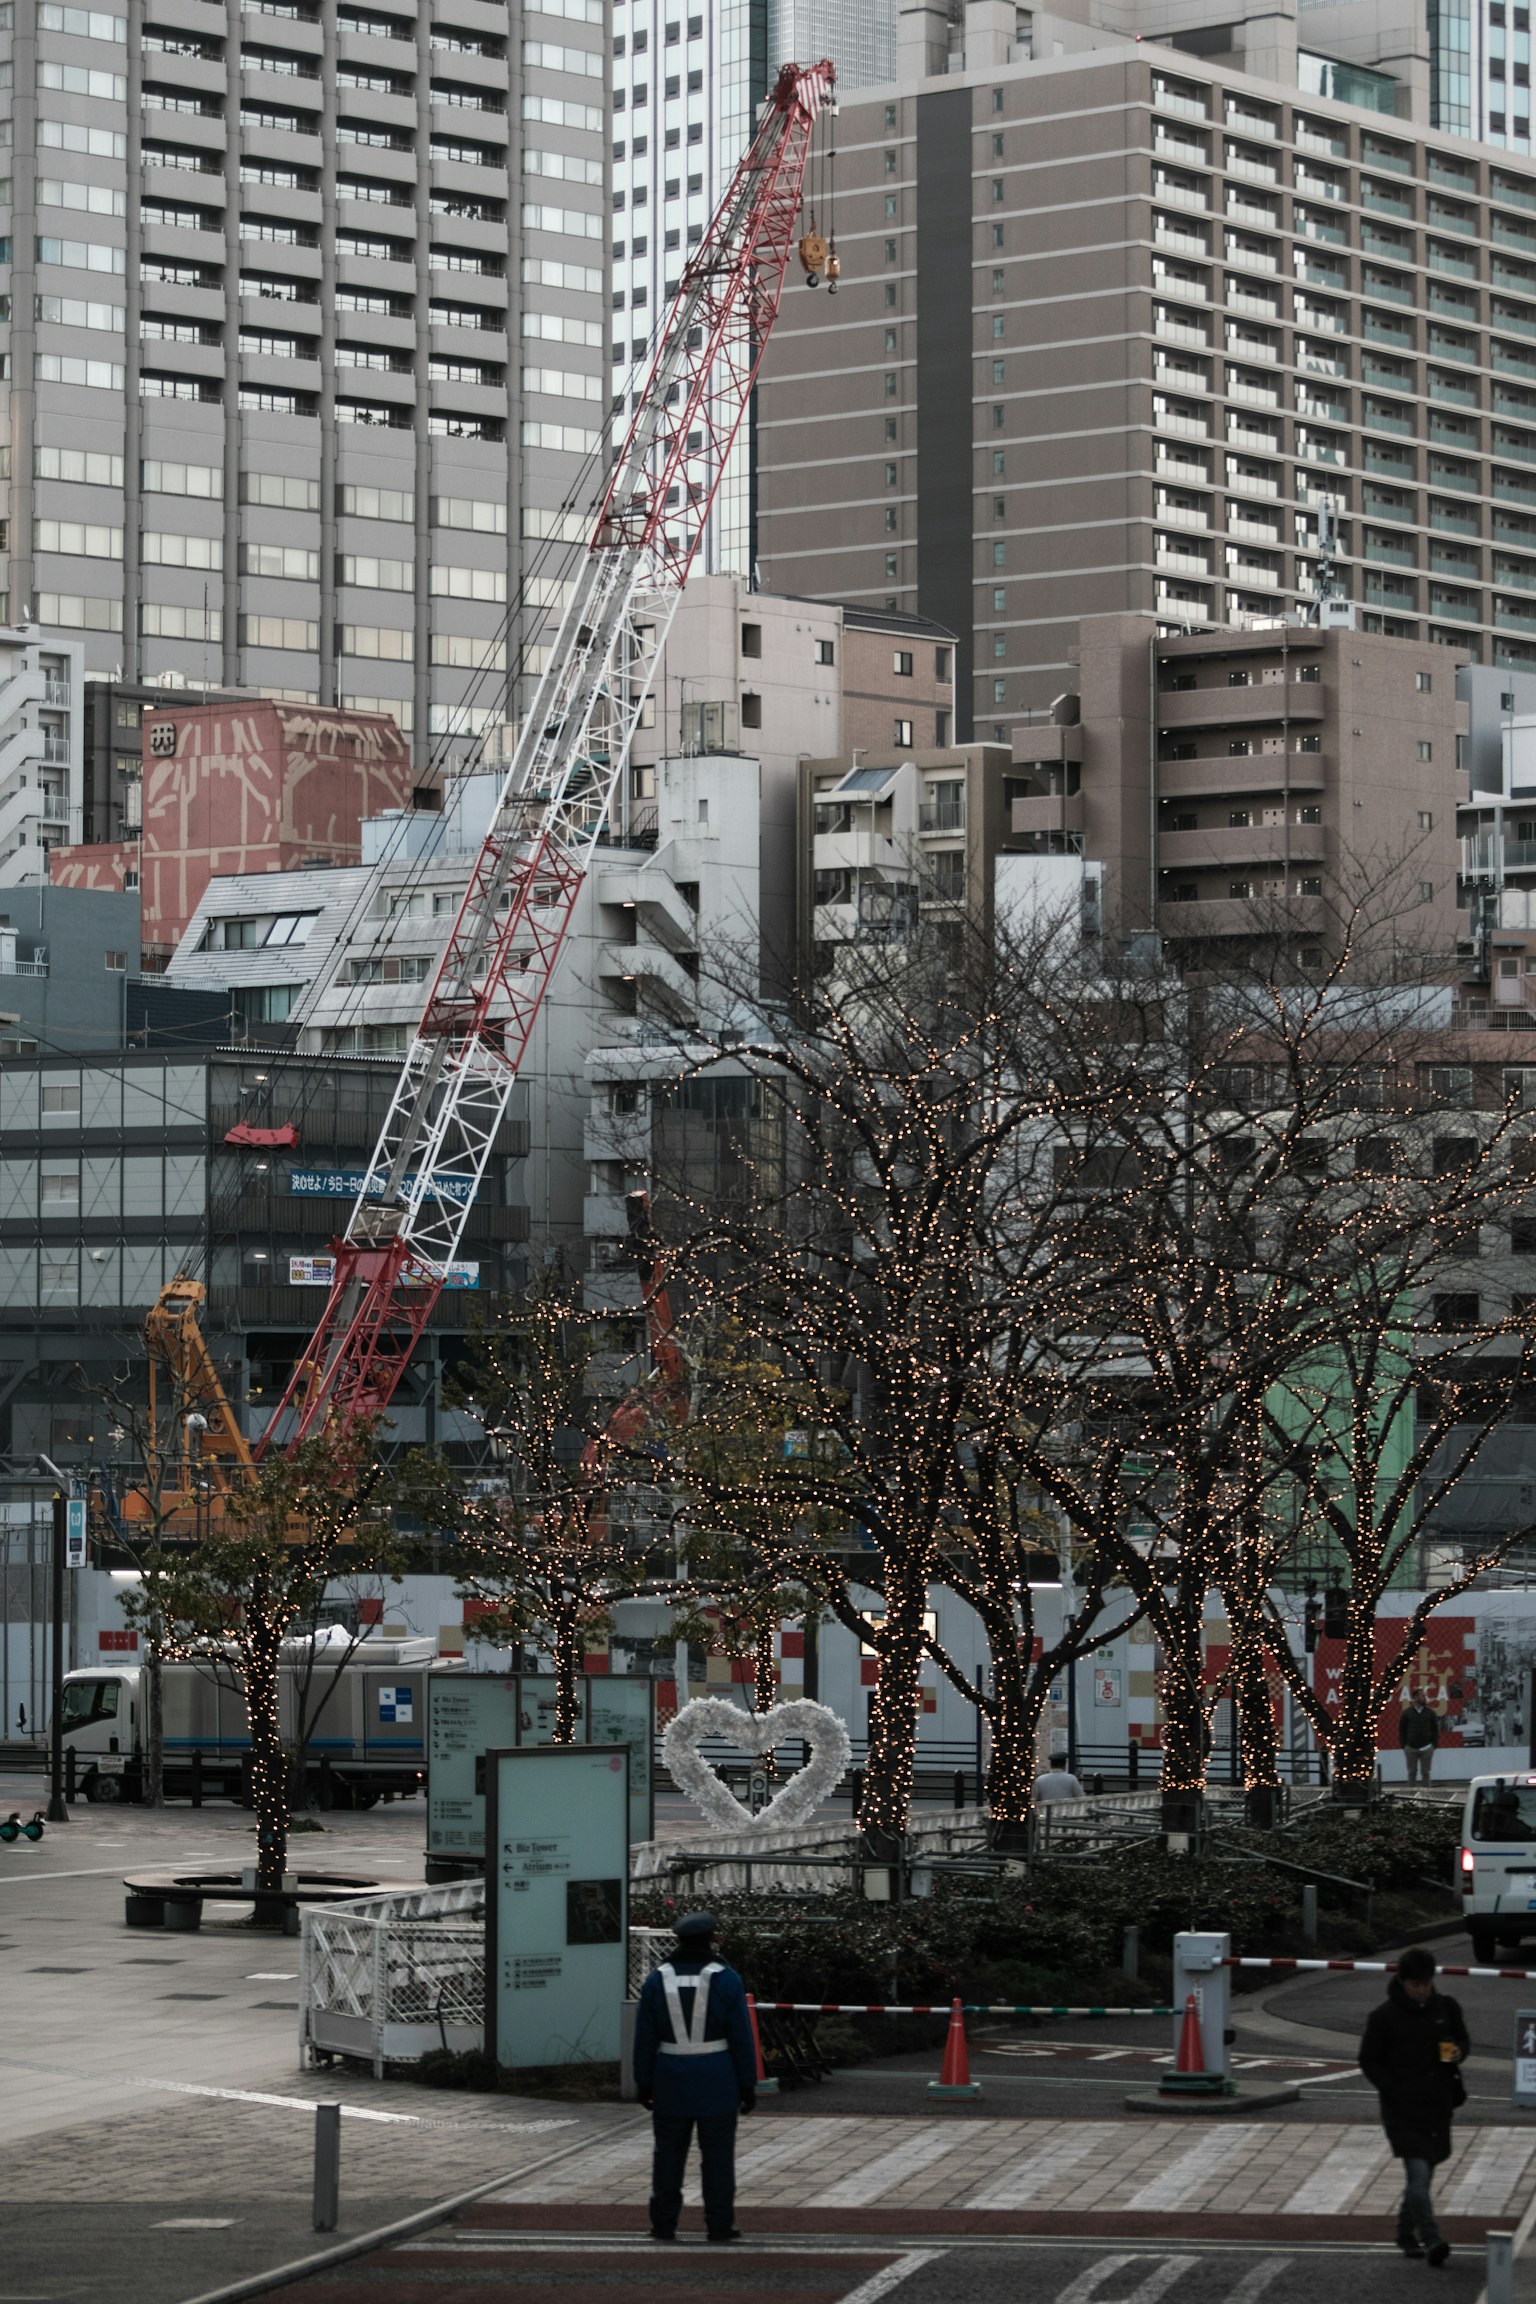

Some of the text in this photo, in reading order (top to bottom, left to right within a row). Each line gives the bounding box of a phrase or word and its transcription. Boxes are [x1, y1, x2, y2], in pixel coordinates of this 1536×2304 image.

[516, 1842, 558, 1853] Biz Tower
[981, 2044, 1328, 2069] STP
